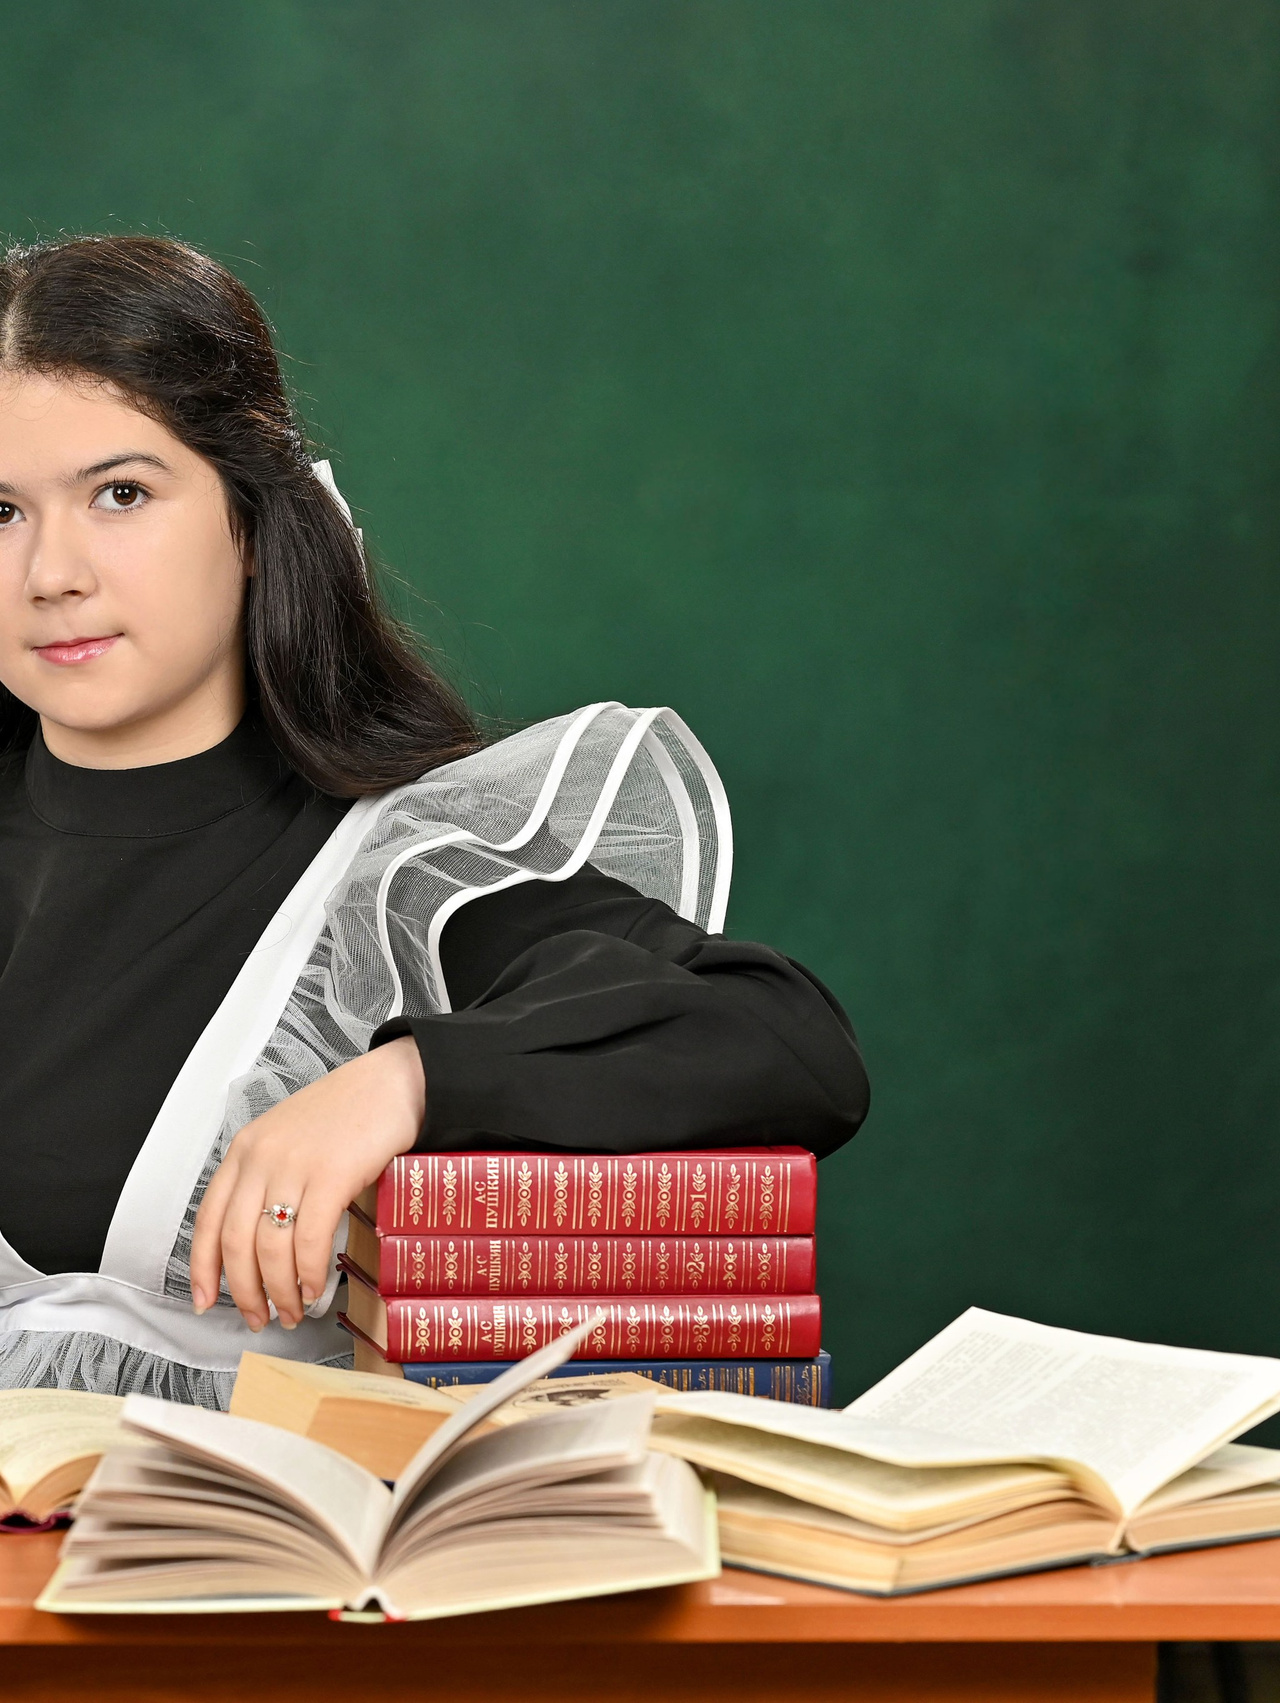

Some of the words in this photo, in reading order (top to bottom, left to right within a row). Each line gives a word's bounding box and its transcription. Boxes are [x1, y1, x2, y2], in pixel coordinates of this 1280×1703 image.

[486, 1157, 499, 1229] ПУШКИН
[690, 1191, 707, 1201] 1
[489, 1240, 501, 1291] ПУШКИН
[686, 1261, 705, 1273] 2
[493, 1305, 506, 1356] ПУШКИН
[693, 1324, 710, 1335] 3
